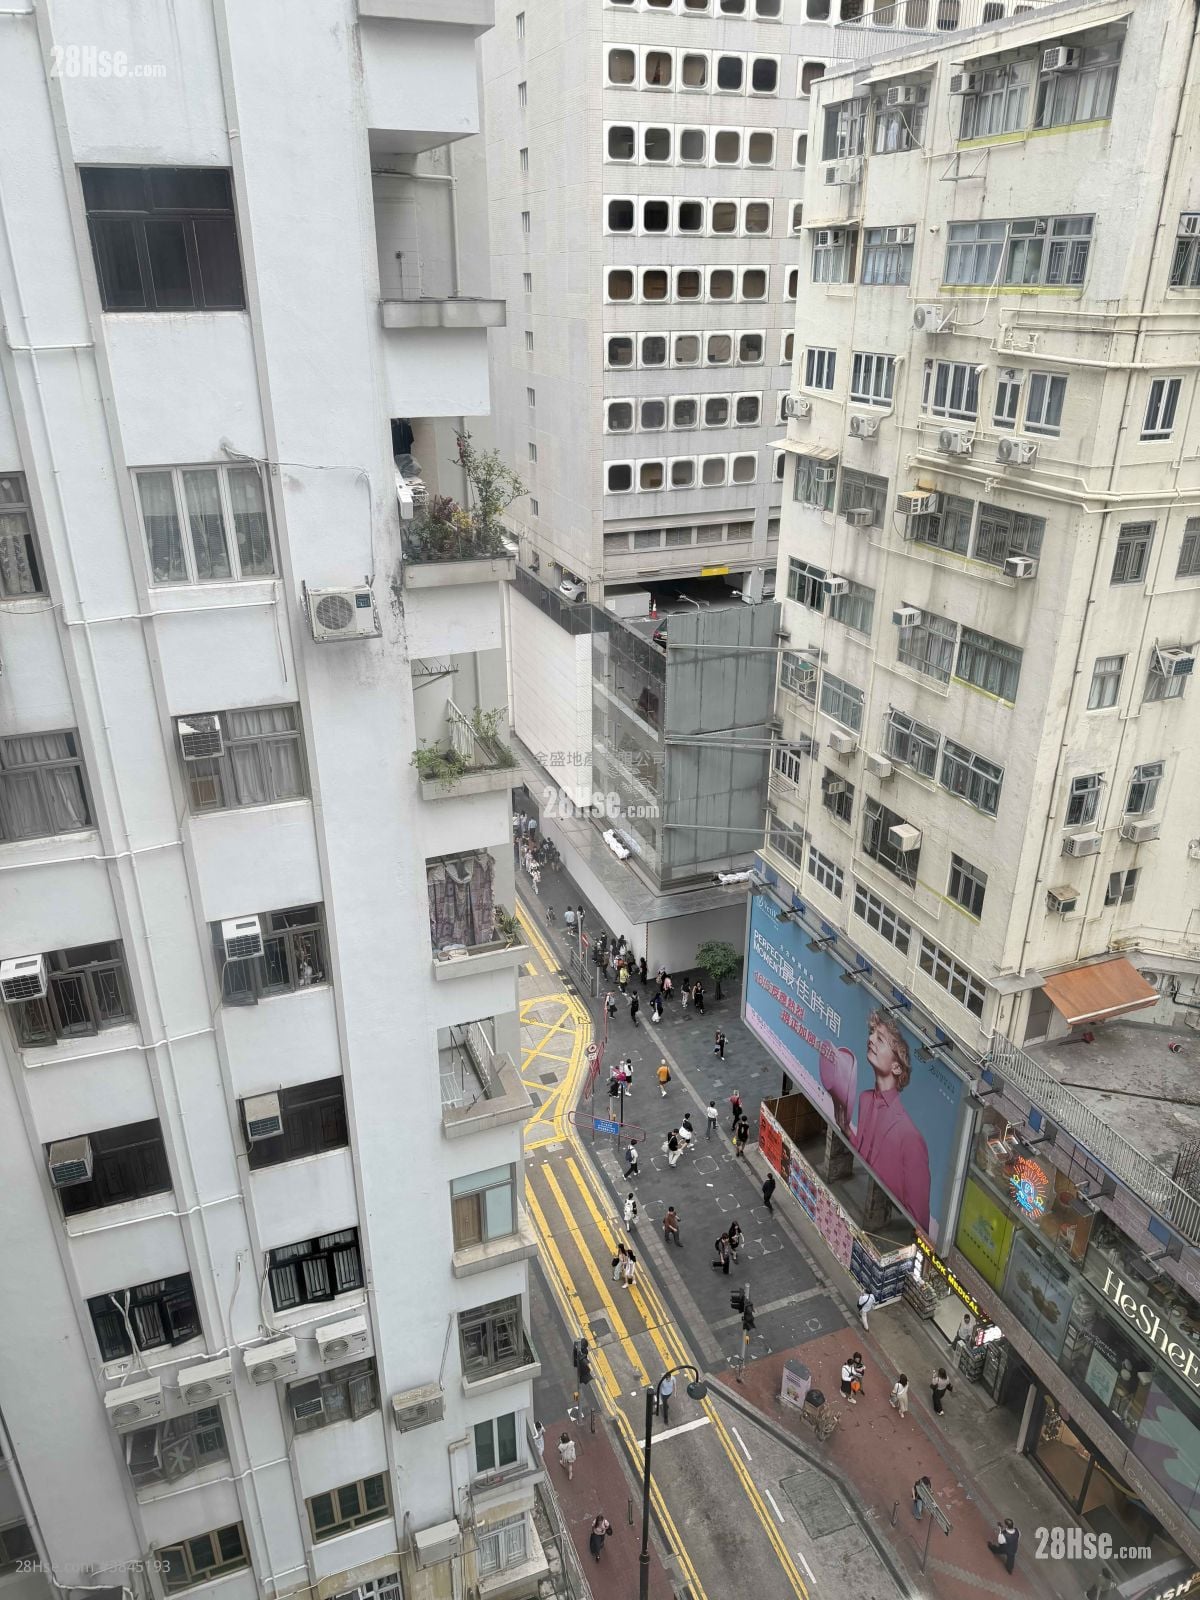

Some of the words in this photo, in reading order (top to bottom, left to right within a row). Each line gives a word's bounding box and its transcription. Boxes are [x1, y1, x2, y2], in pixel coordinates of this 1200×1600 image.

[753, 940, 782, 978] MOMENT
[754, 929, 783, 968] PERFECT
[782, 960, 841, 1039] 最佳時間
[917, 1237, 931, 1257] PAK
[932, 1255, 946, 1276] LOK
[947, 1274, 980, 1316] MEDICAL
